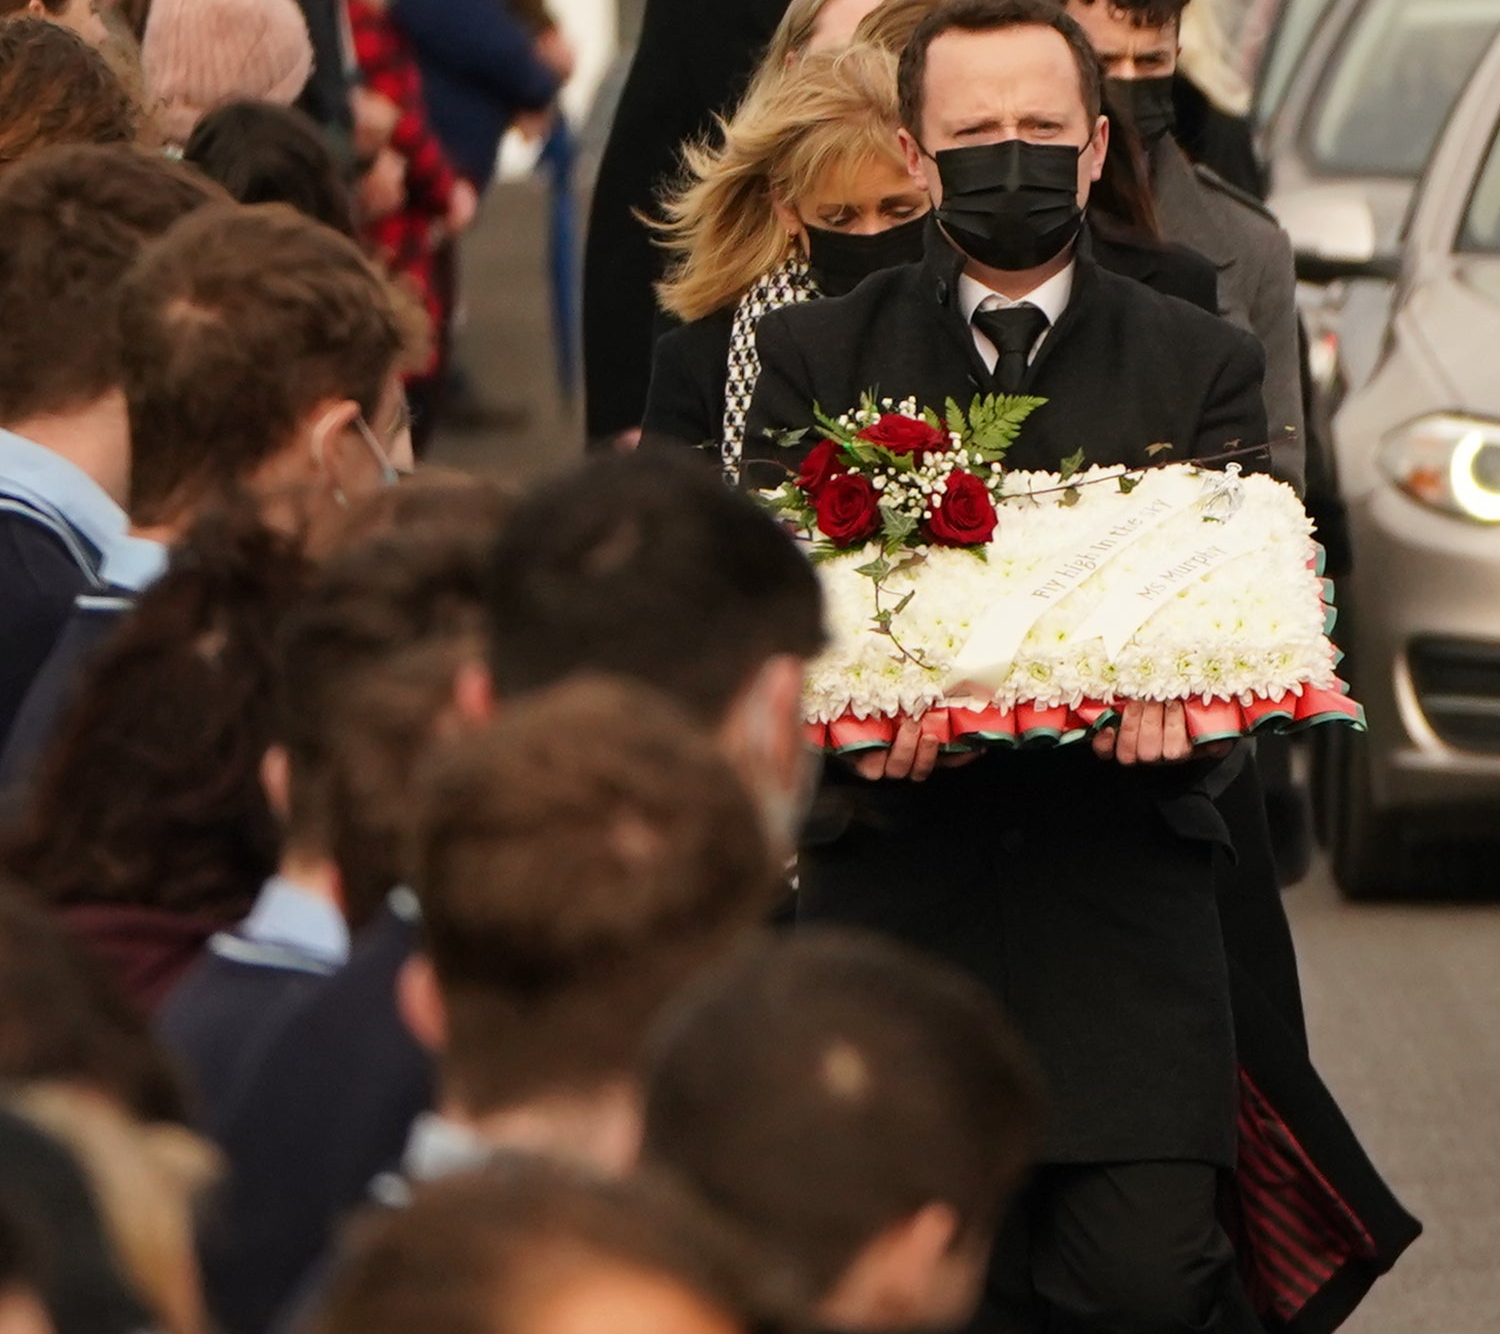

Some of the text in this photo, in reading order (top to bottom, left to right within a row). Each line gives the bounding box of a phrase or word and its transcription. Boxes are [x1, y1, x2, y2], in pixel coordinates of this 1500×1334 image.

[1031, 578, 1067, 599] Fly
[1055, 553, 1102, 578] high
[1108, 517, 1143, 537] the
[1136, 545, 1227, 601] Ms Murphy
